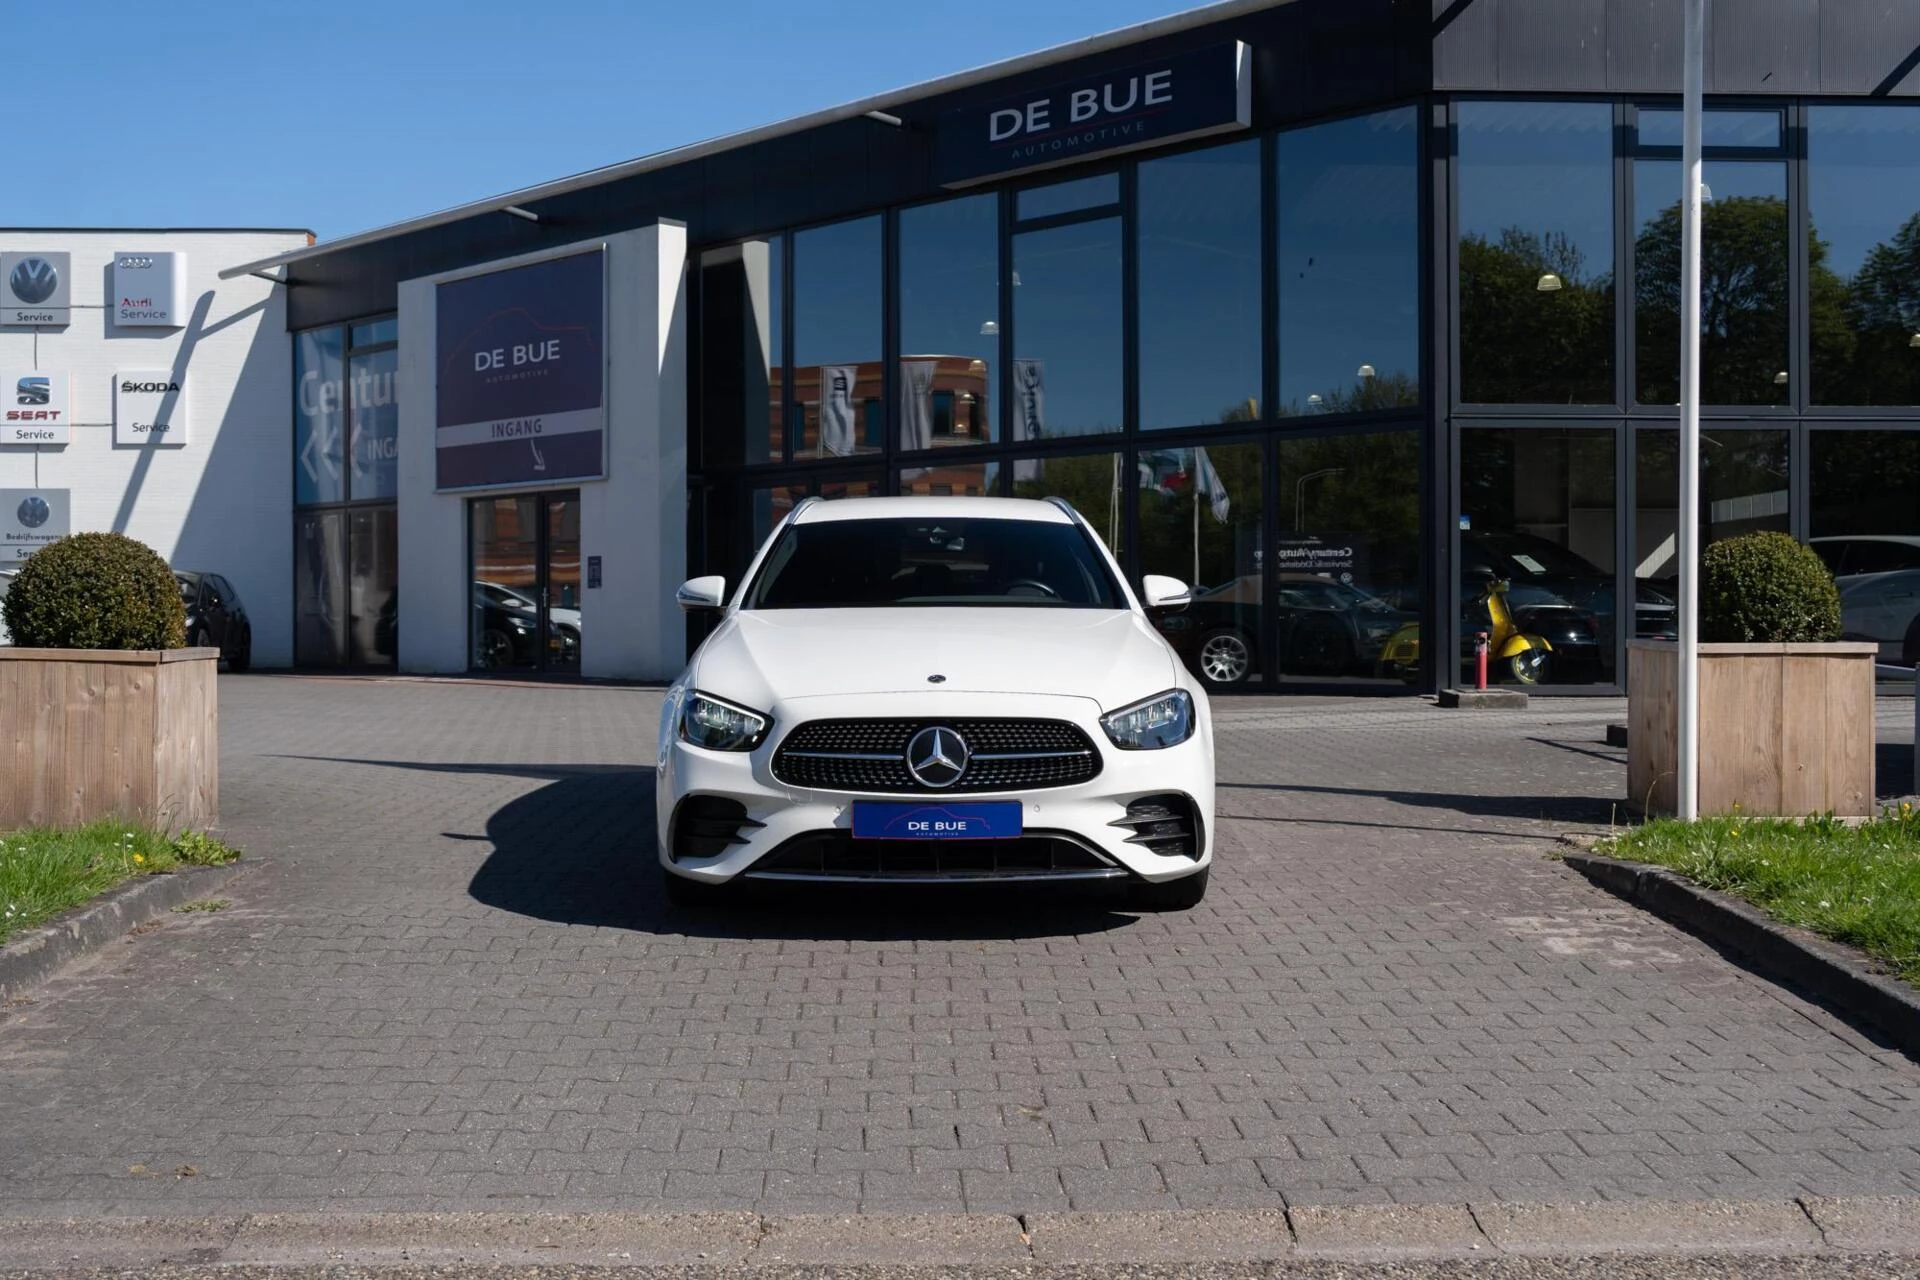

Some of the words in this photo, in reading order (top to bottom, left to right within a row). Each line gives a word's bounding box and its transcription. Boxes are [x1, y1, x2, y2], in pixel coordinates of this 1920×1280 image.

[988, 97, 1052, 142] DE
[1070, 69, 1173, 123] BUE
[1011, 120, 1145, 160] AUTOMOTIVE
[121, 297, 152, 307] Audi
[17, 311, 54, 322] Service
[120, 308, 167, 319] Service
[474, 347, 505, 372] DE
[512, 339, 561, 366] BUE
[485, 369, 549, 384] AUTOMOTIVE
[6, 410, 61, 421] SEAT
[132, 422, 170, 433] Service
[491, 418, 542, 439] INGANG
[16, 429, 54, 440] Service
[367, 436, 398, 460] ING
[907, 821, 930, 831] DE
[934, 821, 967, 831] BUE
